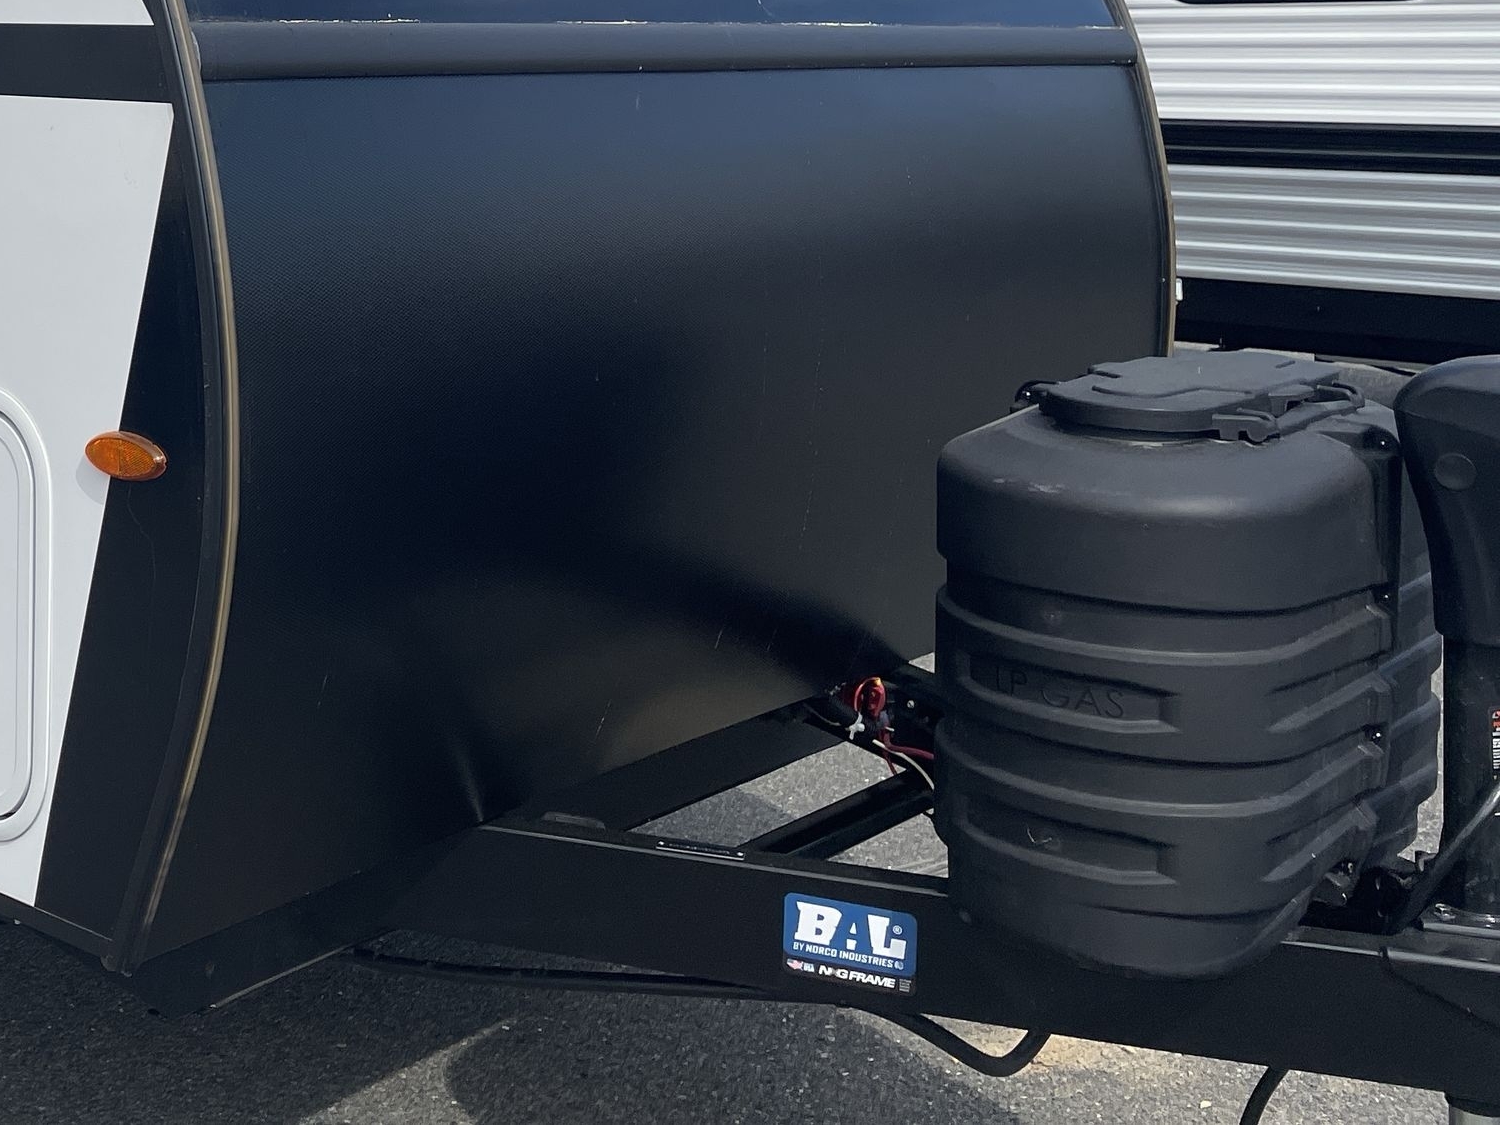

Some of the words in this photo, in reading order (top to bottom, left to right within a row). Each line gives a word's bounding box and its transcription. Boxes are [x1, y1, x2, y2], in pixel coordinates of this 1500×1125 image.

[1040, 678, 1125, 719] GAS
[794, 901, 907, 960] BAL
[792, 941, 804, 951] BY
[805, 942, 837, 958] NORCO
[839, 949, 894, 969] INDUSTRIES
[848, 970, 896, 989] FRAME
